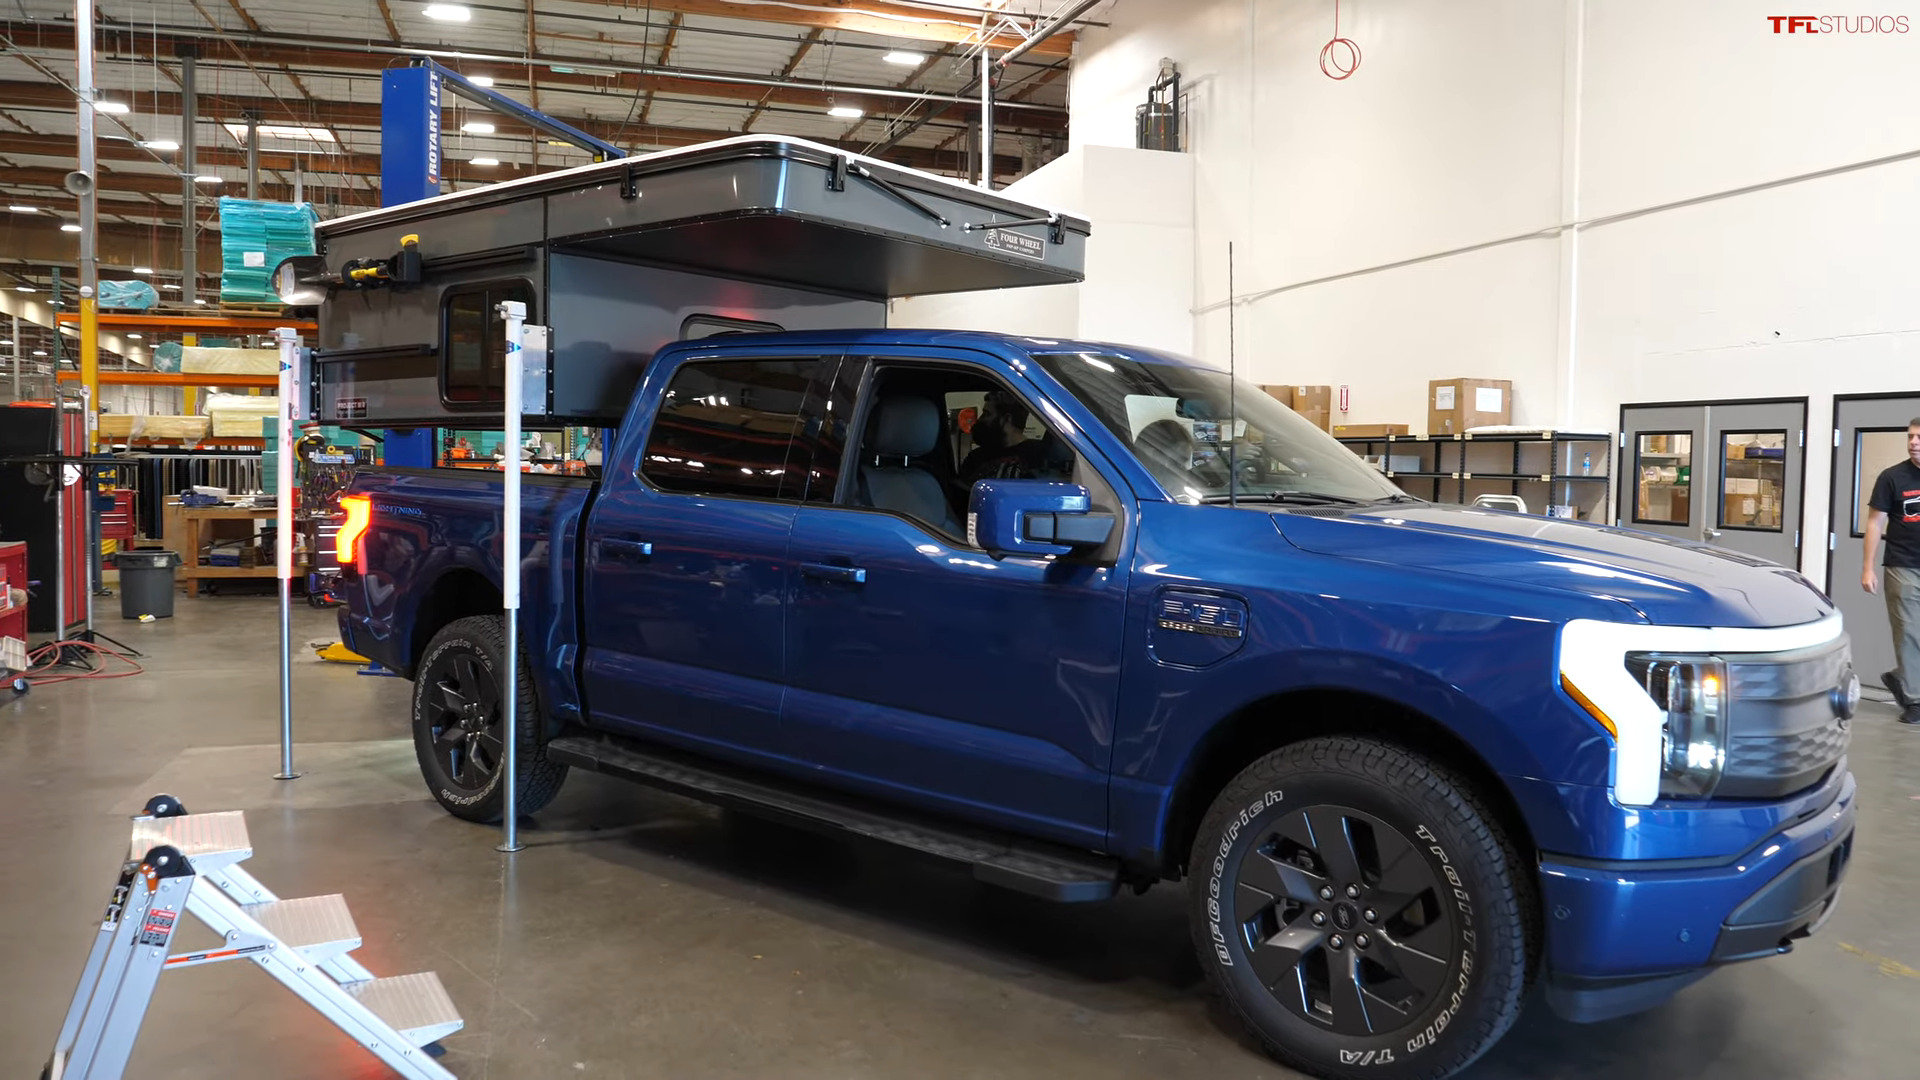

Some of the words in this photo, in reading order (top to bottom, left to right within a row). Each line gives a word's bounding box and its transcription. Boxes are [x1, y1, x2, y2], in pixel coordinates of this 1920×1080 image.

[429, 70, 438, 106] LIFT
[428, 109, 438, 175] ROTARY
[1001, 233, 1018, 244] FOUR
[1019, 238, 1041, 250] WHEEL
[373, 503, 422, 515] LIGHTNING
[1160, 599, 1243, 628] F-150
[1207, 789, 1284, 967] BFGoodrich
[1406, 824, 1477, 1053] Trail-Terrain
[1339, 1048, 1395, 1066] T/A
